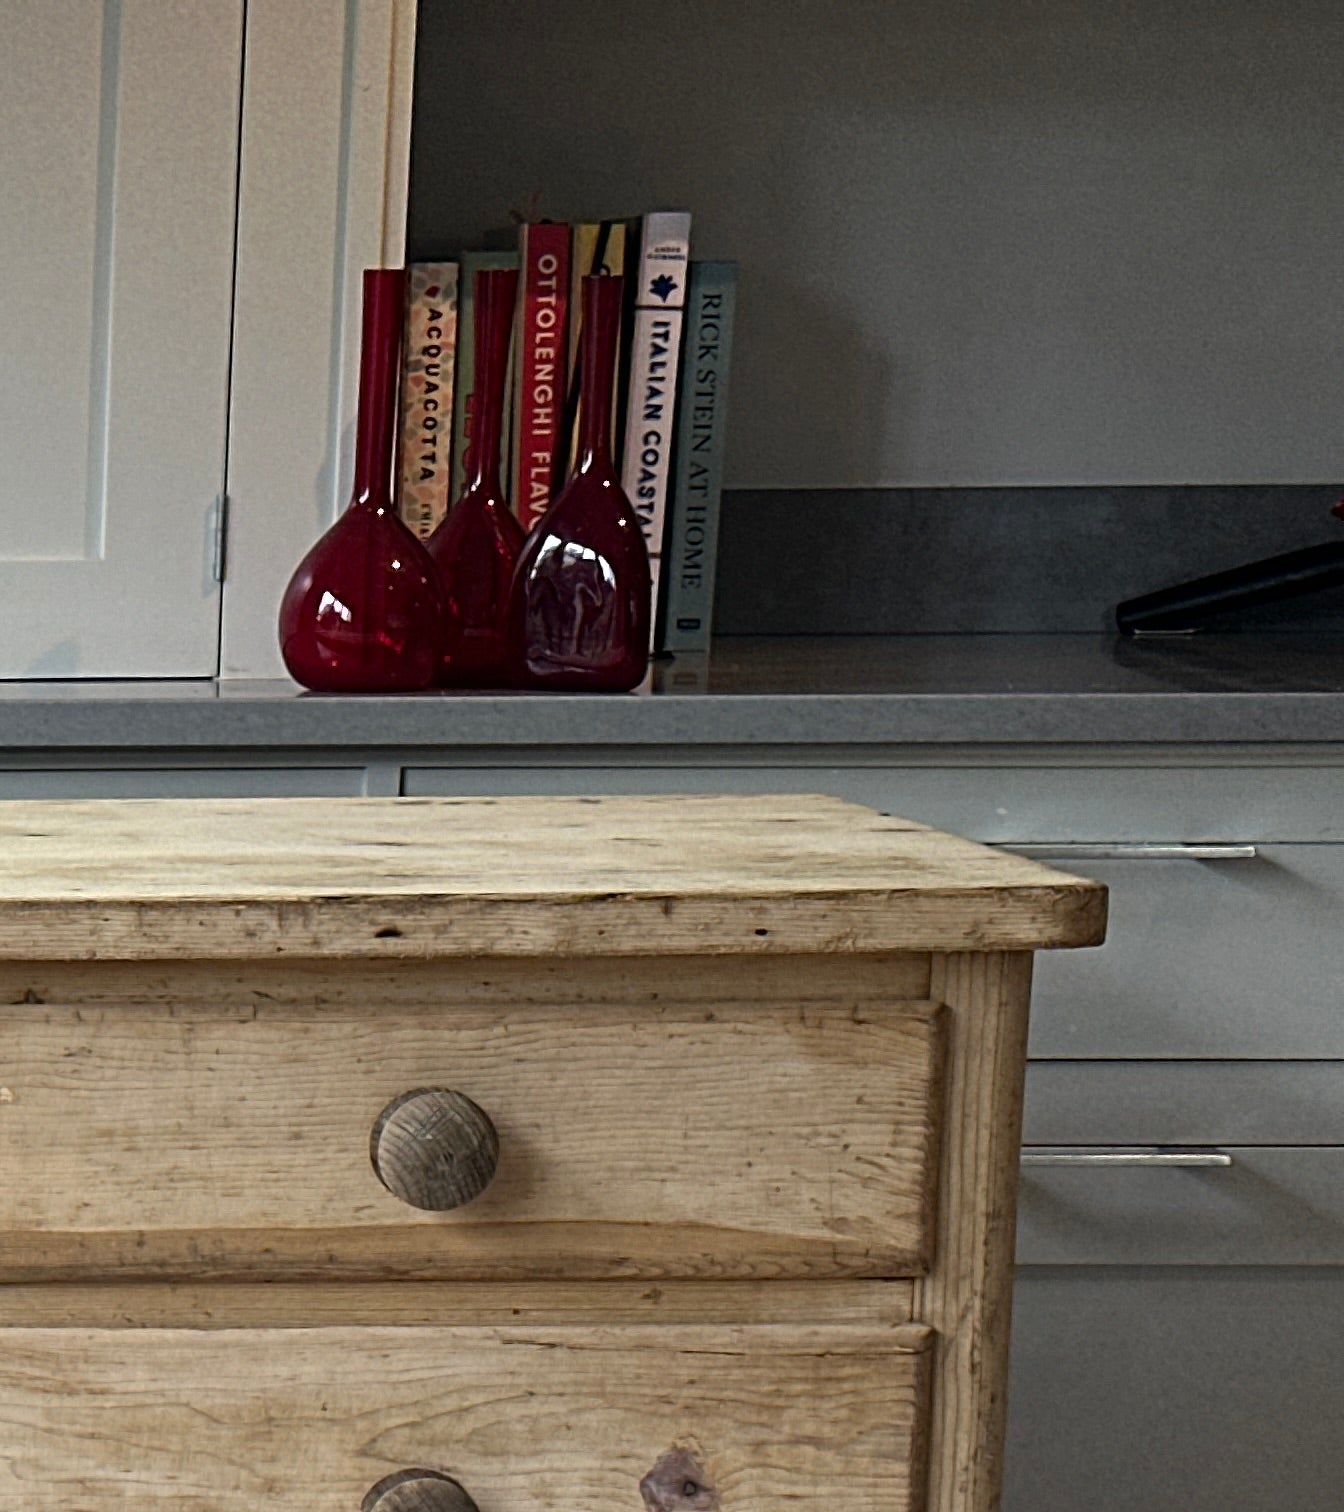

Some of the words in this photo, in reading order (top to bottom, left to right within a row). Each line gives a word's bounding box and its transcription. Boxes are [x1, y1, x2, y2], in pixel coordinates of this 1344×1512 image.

[530, 253, 558, 436] OTTOLENGHI
[697, 293, 722, 361] RICK
[420, 308, 443, 481] ACQUACOTTA
[642, 320, 671, 422] ITALIAN
[692, 370, 717, 453] STEIN
[688, 462, 710, 498] AT
[681, 505, 707, 590] HOME
